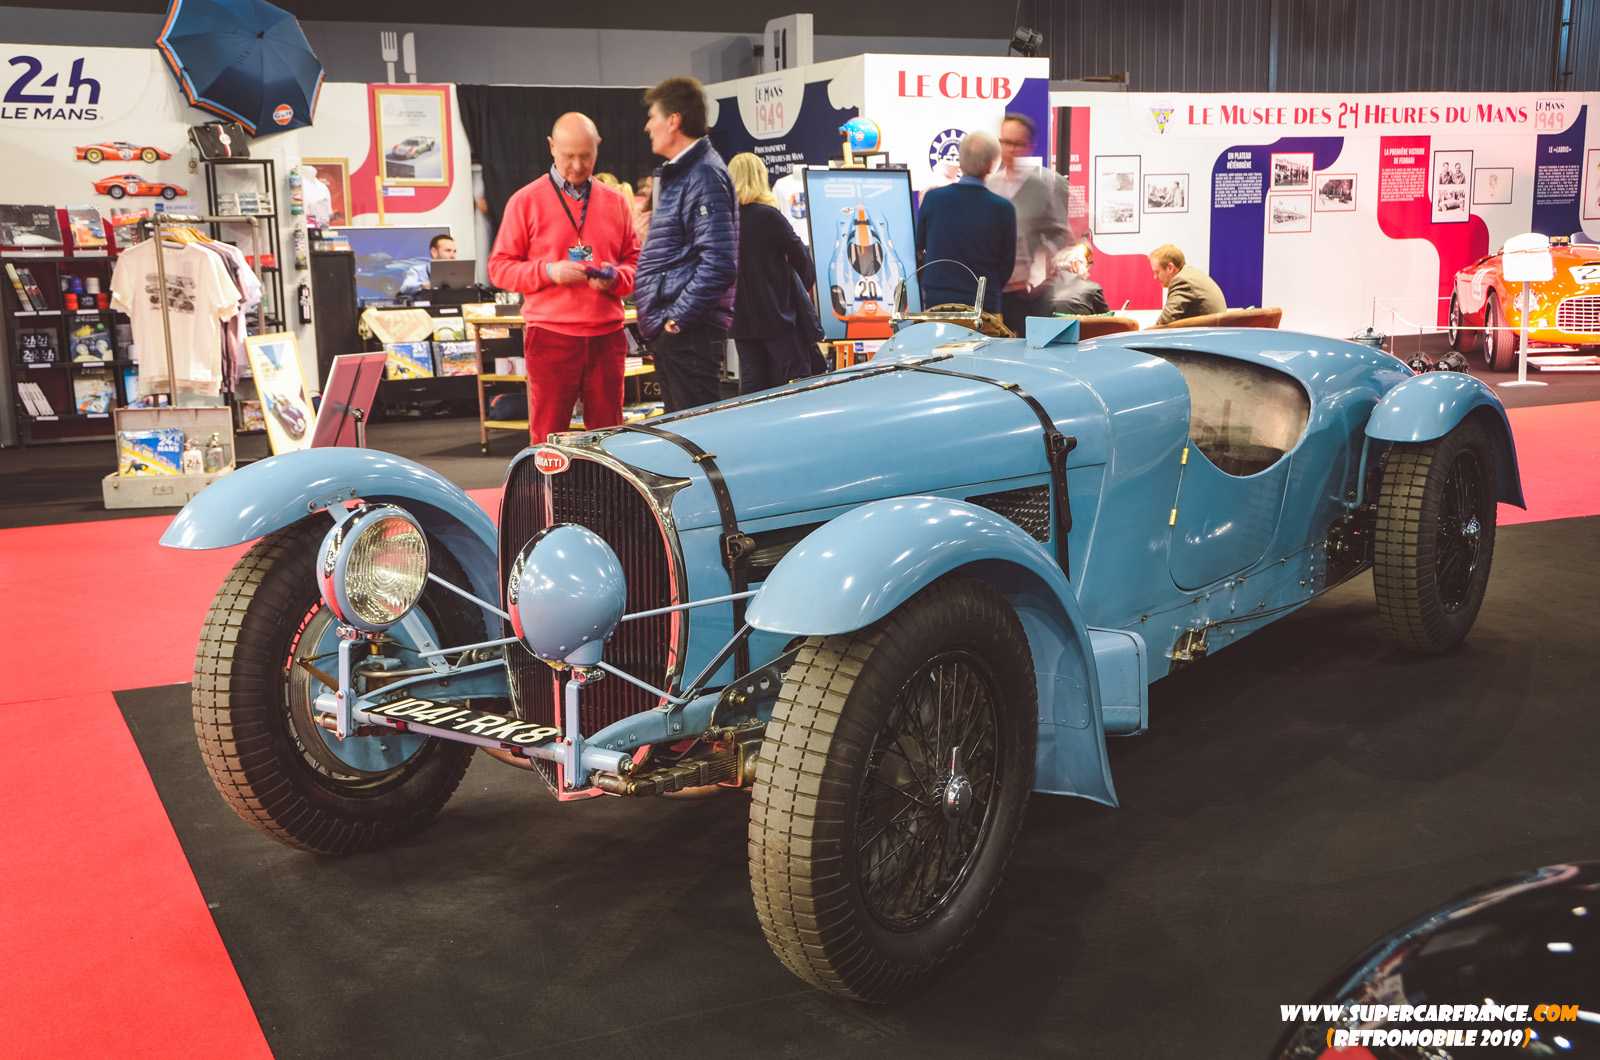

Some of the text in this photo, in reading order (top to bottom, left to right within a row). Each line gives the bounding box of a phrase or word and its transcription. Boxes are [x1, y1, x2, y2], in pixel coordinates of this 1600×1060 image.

[4, 55, 101, 105] 24h
[898, 70, 1012, 100] LE CLUB
[755, 84, 783, 103] LE MANS
[1, 107, 98, 120] LE MANS
[1535, 100, 1565, 112] LE MANS
[755, 101, 784, 132] 1949
[1188, 102, 1528, 129] LE MUSEE DES 24 HEURES DU MANS
[1534, 112, 1564, 129] 1949
[1234, 152, 1252, 160] PLATEAU
[1384, 148, 1390, 156] LA
[1390, 147, 1408, 155] PREMIÈRE
[824, 184, 893, 199] 917
[859, 280, 878, 300] 20
